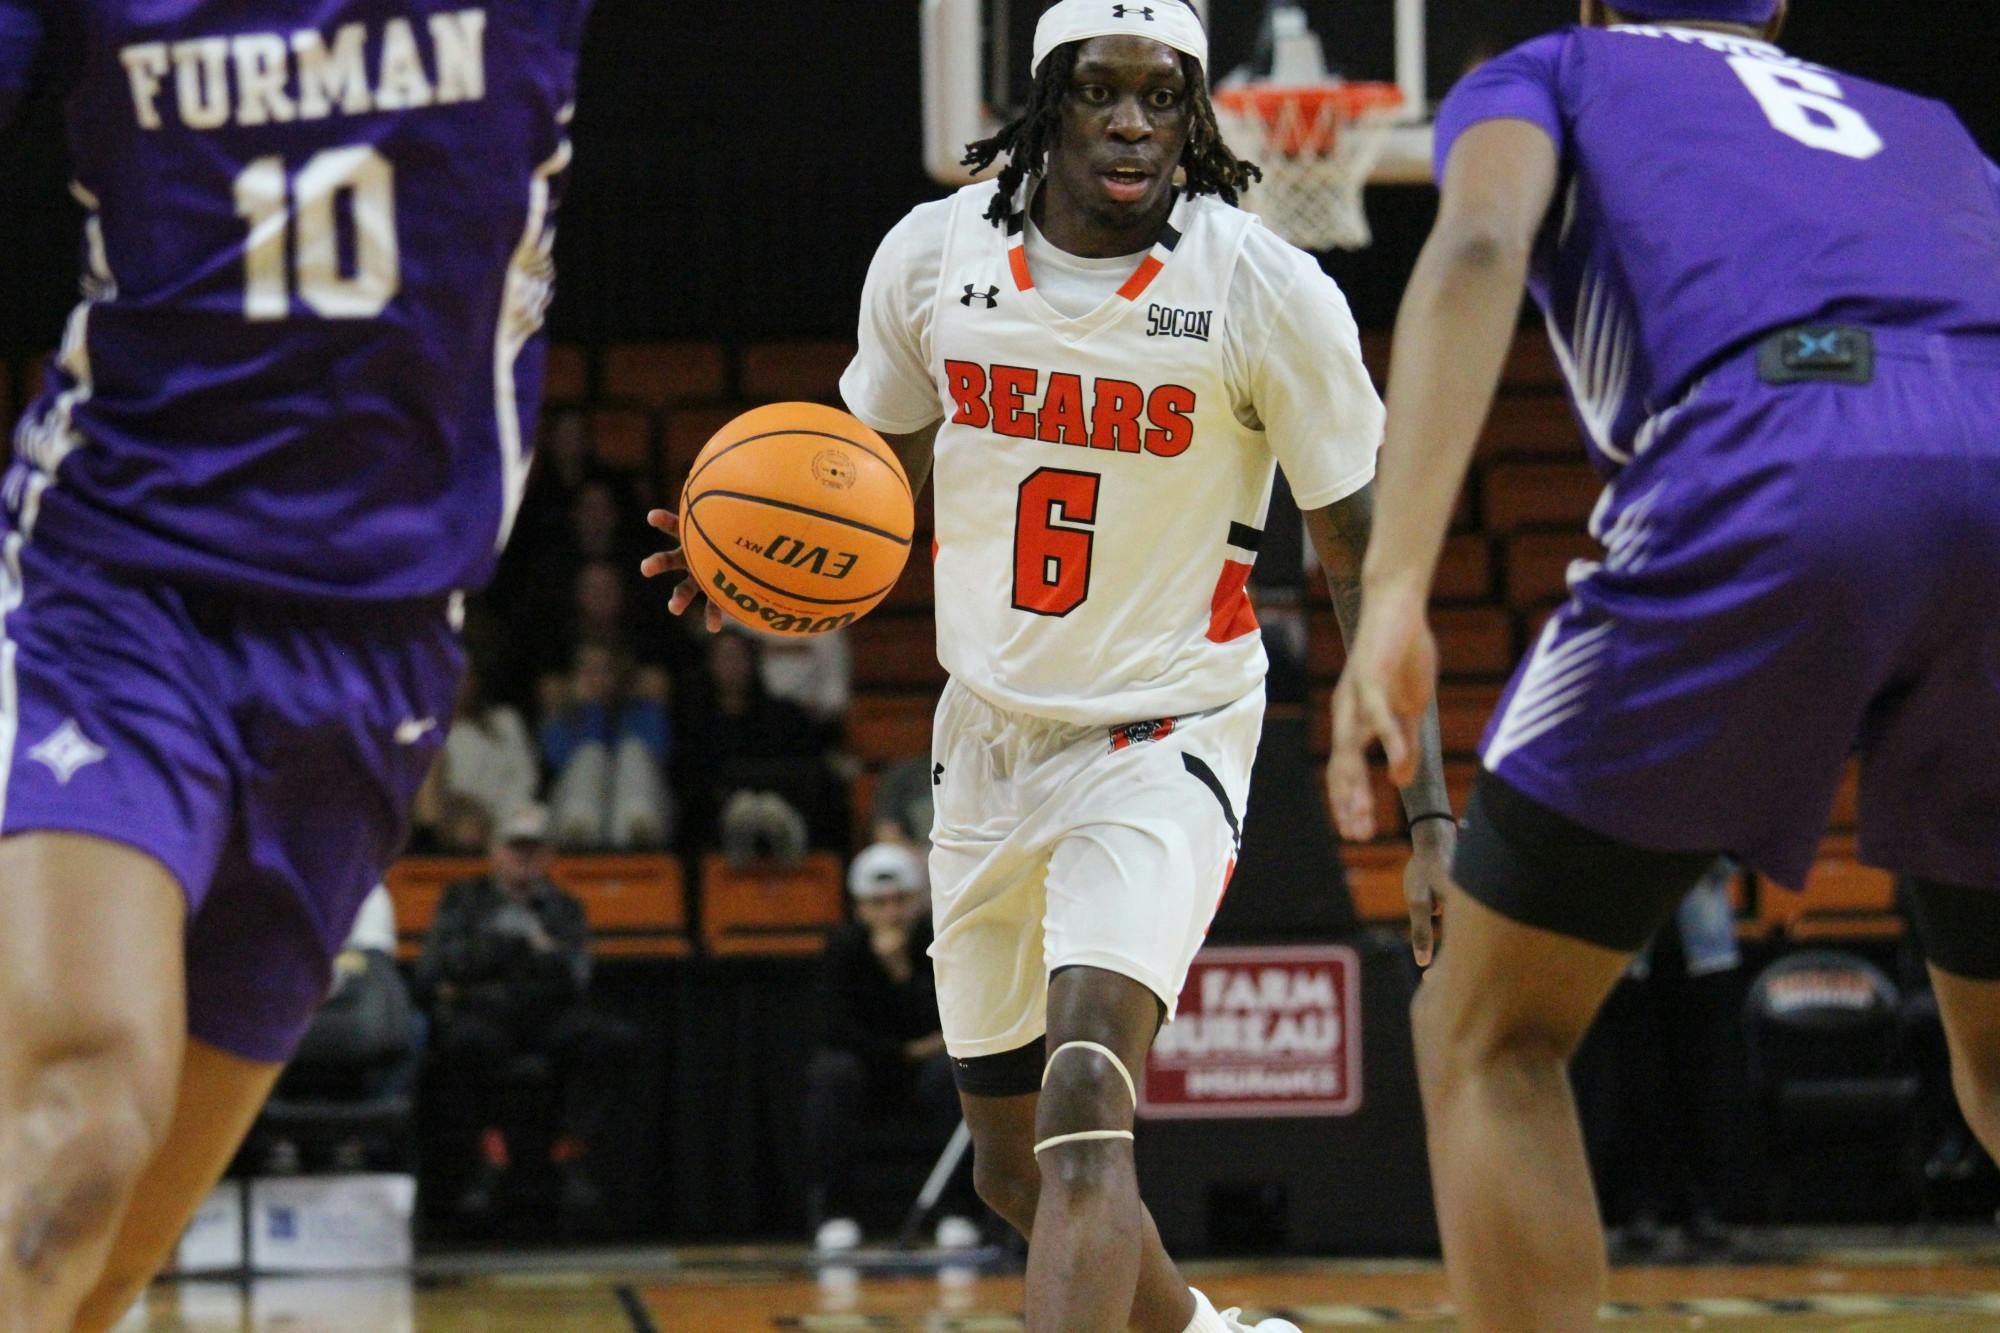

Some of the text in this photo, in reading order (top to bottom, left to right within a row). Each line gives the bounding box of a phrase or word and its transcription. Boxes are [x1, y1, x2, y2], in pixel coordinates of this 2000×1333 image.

[119, 8, 487, 131] FURMAN
[1725, 54, 1885, 160] 6
[233, 143, 399, 322] 10
[944, 358, 1197, 458] BEARS
[734, 535, 859, 579] EVO NXT
[1011, 466, 1101, 618] 6
[1152, 1011, 1343, 1058] BUREAU
[1202, 968, 1337, 1011] FARM
